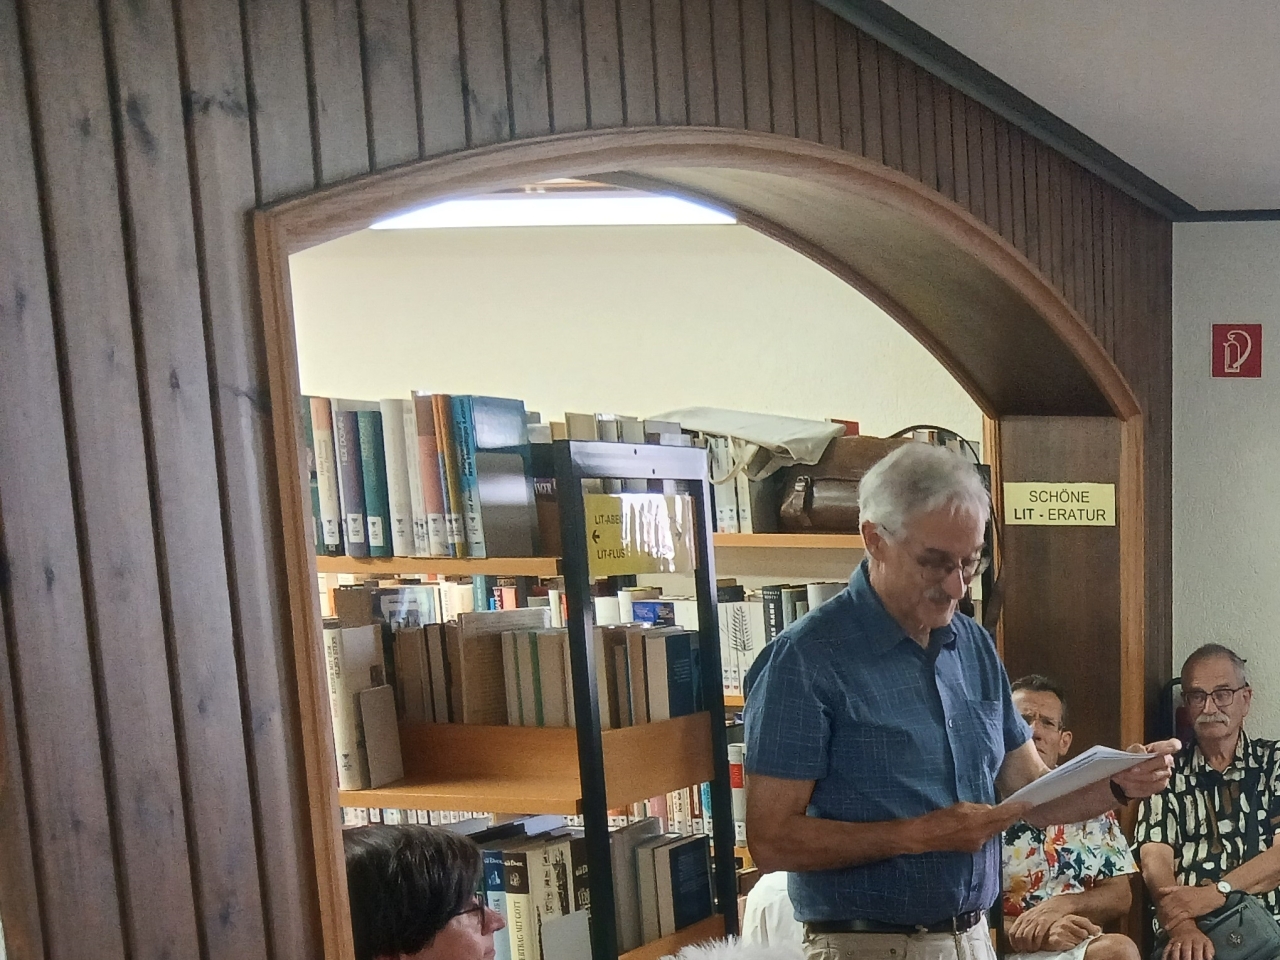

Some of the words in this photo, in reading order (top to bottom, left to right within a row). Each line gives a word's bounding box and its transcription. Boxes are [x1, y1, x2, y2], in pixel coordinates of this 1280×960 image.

[1029, 489, 1090, 503] SCHÖNE
[1014, 508, 1034, 520] LIT
[1048, 508, 1106, 521] ERATUR
[513, 900, 522, 919] GOTT
[515, 920, 523, 933] MIT
